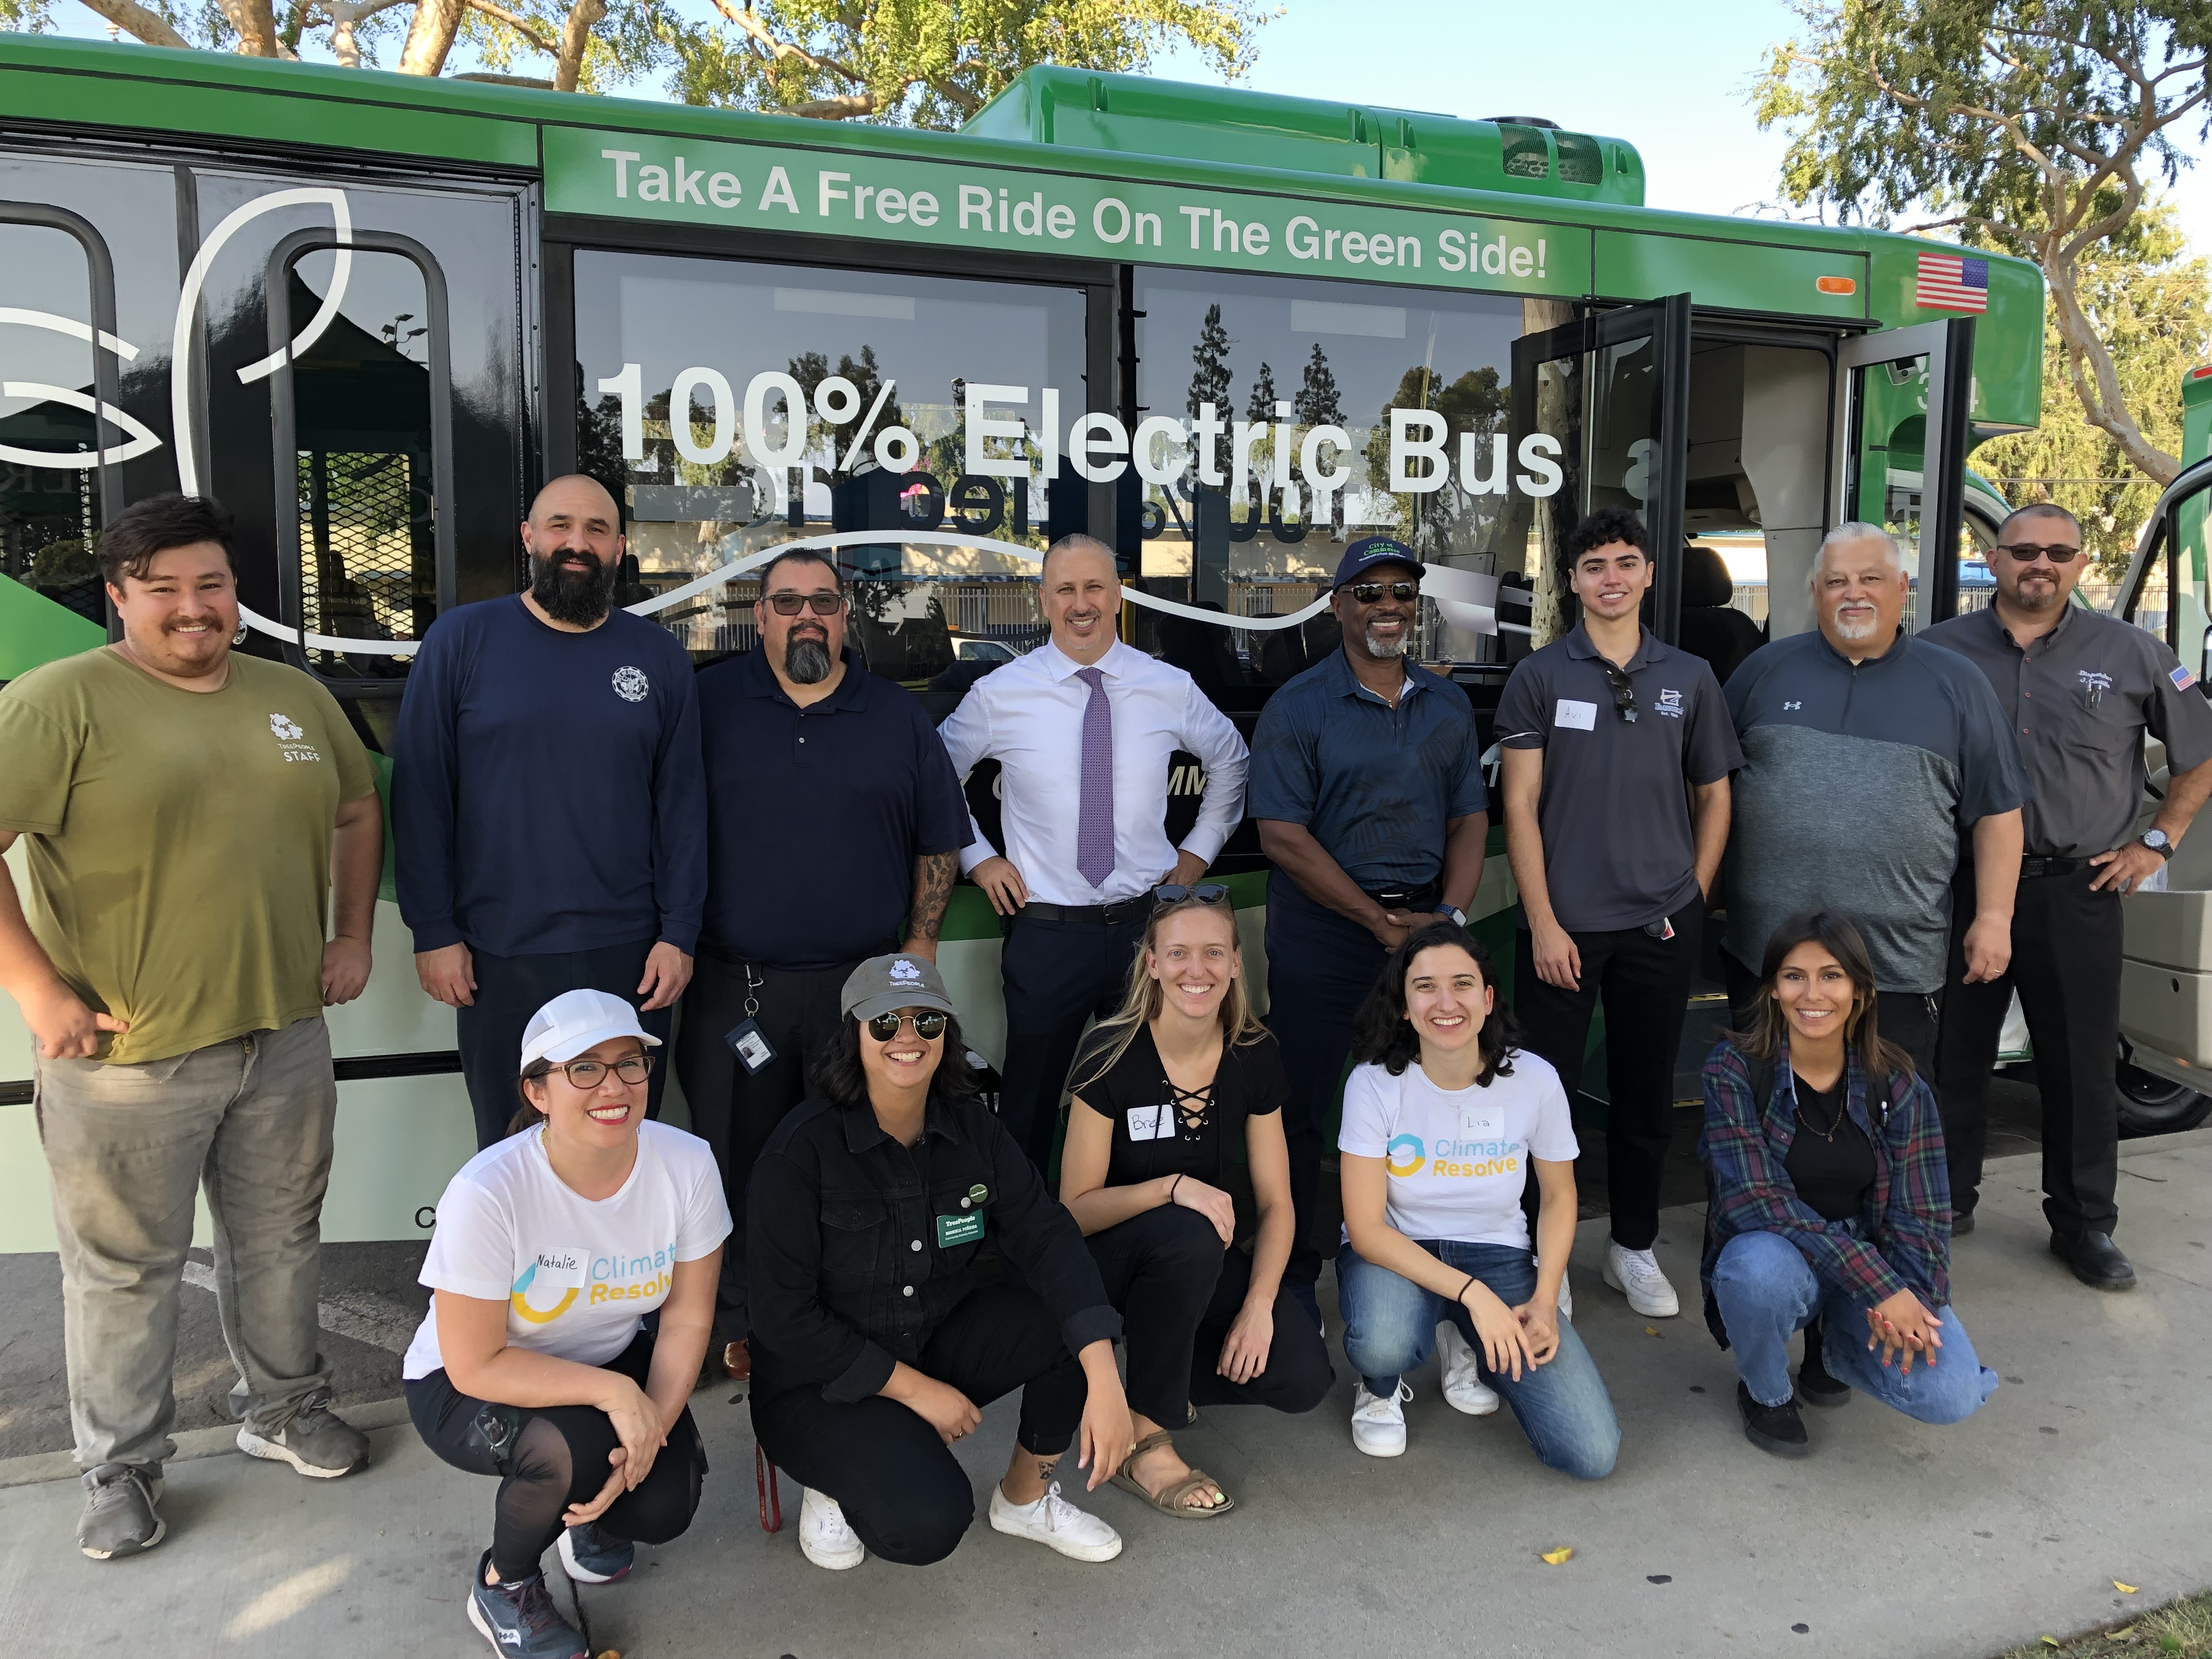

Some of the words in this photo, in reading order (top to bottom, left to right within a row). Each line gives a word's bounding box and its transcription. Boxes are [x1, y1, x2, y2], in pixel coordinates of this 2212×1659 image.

[601, 149, 742, 209] Take
[758, 166, 800, 214] A
[819, 171, 939, 227] Free
[959, 184, 1076, 239] Ride
[1092, 198, 1161, 246] On
[1179, 205, 1270, 255] The
[1285, 216, 1421, 268] Green
[1438, 229, 1547, 279] Side!
[597, 363, 919, 473] 100%
[964, 383, 1352, 493] Electric
[1389, 408, 1564, 498] Bus
[1363, 548, 1400, 556] Commerce
[1564, 706, 1583, 720] Avi
[284, 751, 321, 763] STAFF
[1468, 1116, 1490, 1128] Lia
[1435, 1139, 1520, 1158] Climate
[1432, 1158, 1518, 1177] Resolve
[946, 1215, 975, 1227] TreePeople
[536, 1254, 578, 1270] Natalie
